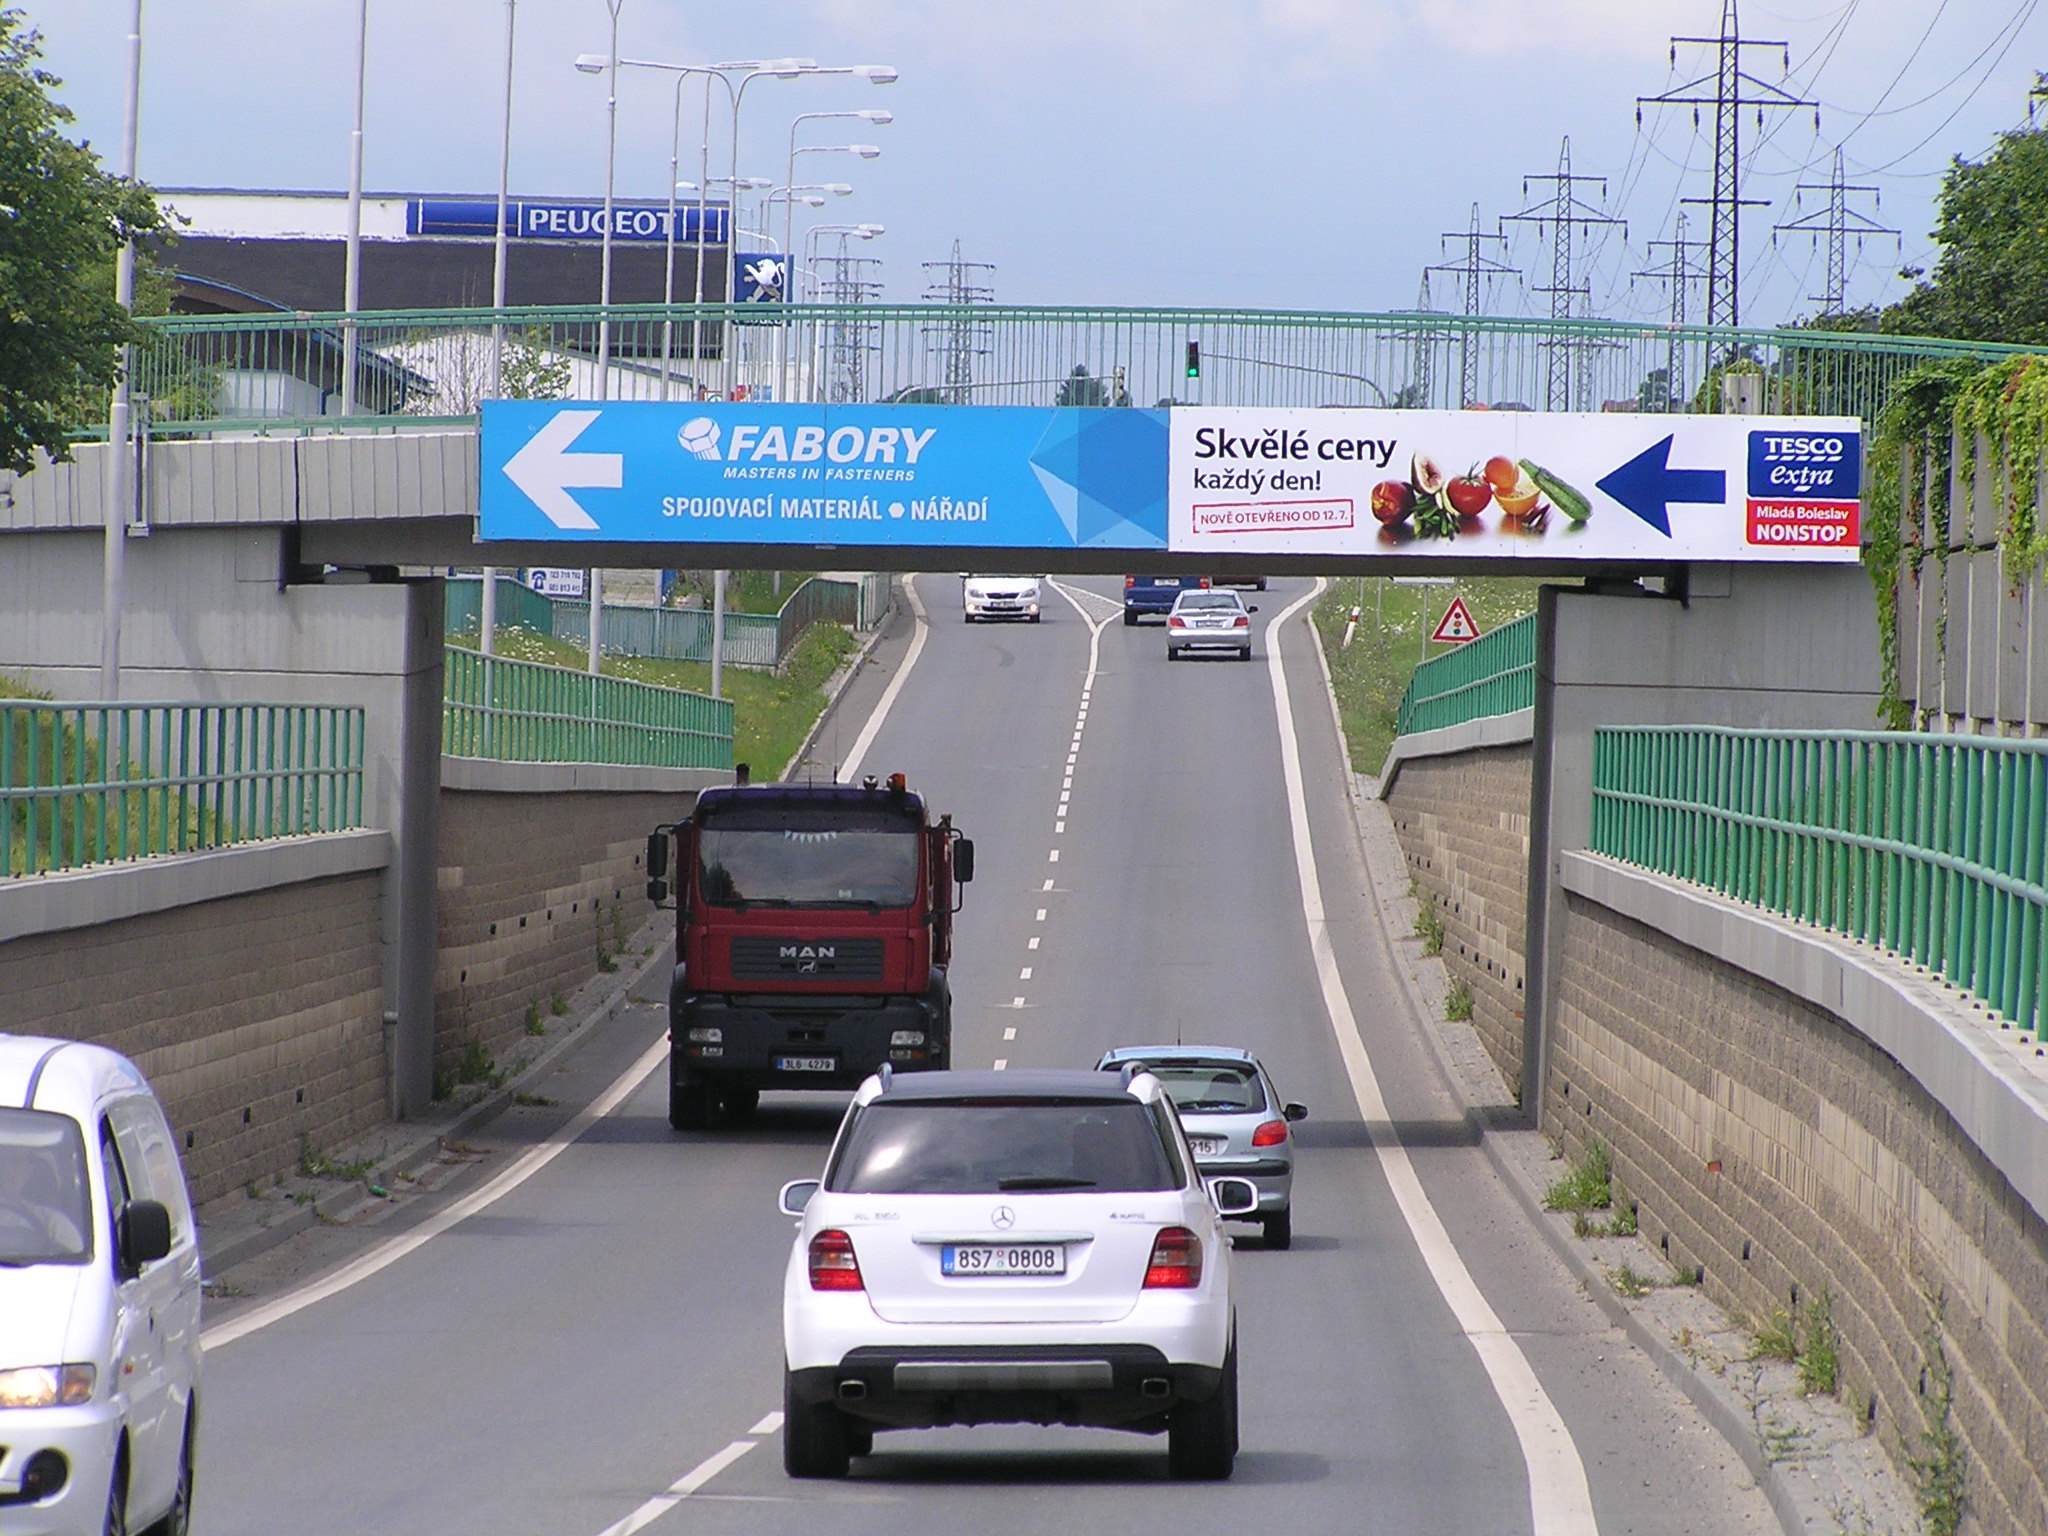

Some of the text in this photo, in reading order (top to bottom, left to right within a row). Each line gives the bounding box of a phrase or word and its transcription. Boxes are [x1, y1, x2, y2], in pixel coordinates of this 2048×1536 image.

[530, 208, 677, 235] PEUGEOT
[728, 425, 937, 464] FABORY
[1194, 427, 1398, 469] Skvělé ceny
[1763, 437, 1844, 455] TESCO
[723, 467, 916, 482] MASTERS IN FASTENERS
[1193, 467, 1322, 496] každý den!
[1769, 465, 1834, 486] extra
[661, 493, 990, 522] SPOJOVACÍ MATERIÁL NÁŘADÍ
[1234, 509, 1301, 524] OTEVŘENO
[1302, 510, 1321, 522] OD
[1756, 505, 1849, 520] Mladá Boleslav
[1756, 524, 1848, 542] NONSTOP
[780, 946, 836, 958] MAN
[959, 1249, 993, 1269] 8S7
[1008, 1249, 1055, 1268] 0808
